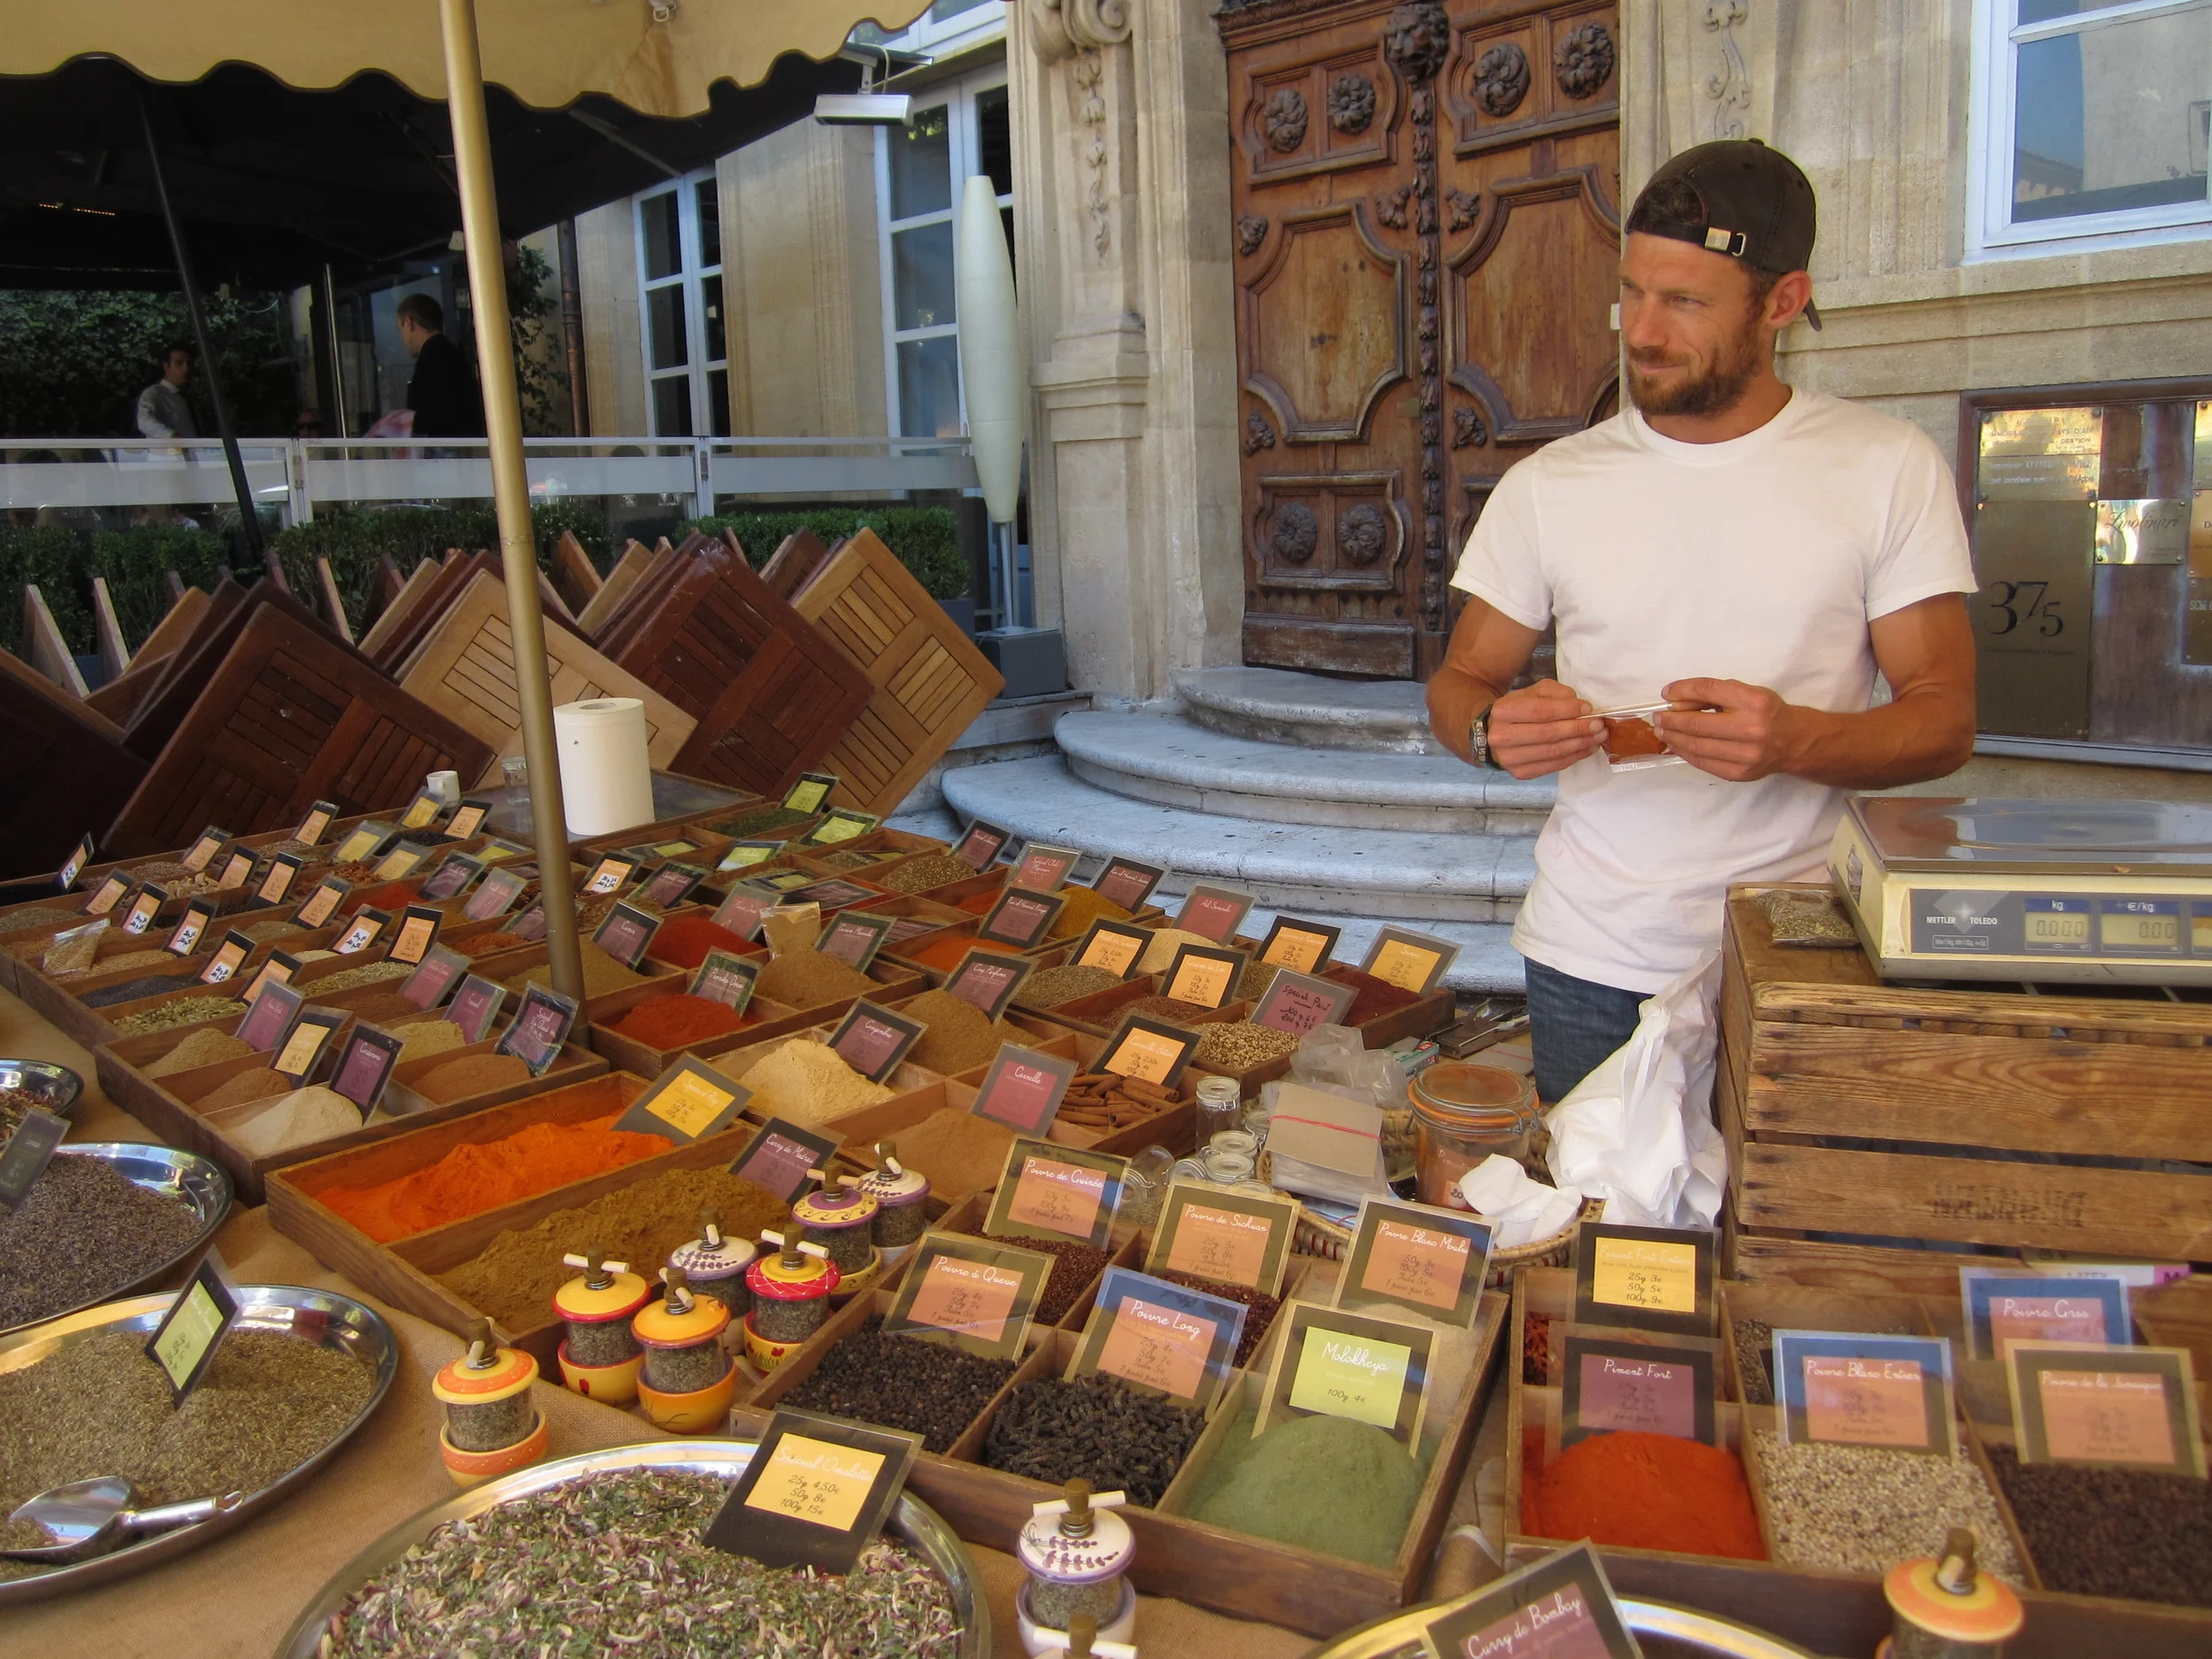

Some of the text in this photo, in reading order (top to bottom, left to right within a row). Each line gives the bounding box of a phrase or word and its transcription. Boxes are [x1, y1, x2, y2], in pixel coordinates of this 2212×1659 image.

[2052, 900, 2063, 911] kg
[2127, 902, 2154, 913] €/kg
[1926, 916, 1998, 926] METTLER TOLEDO
[1025, 1159, 1055, 1179] Poivre
[1056, 1170, 1068, 1182] de
[1184, 1204, 1268, 1233] Poivre de Sichuan
[1379, 1222, 1409, 1240] Poivre
[1410, 1229, 1438, 1247] Blanc
[934, 1256, 1018, 1286] Poivre à Queue
[1627, 1272, 1647, 1285] 25g
[1627, 1283, 1645, 1295] 50g
[1626, 1293, 1647, 1305] 100g
[2003, 1299, 2050, 1317] Poivre
[1130, 1300, 1202, 1340] Poivre Long
[1321, 1340, 1388, 1377] Molokheya
[1603, 1358, 1672, 1379] Piment Fort
[1326, 1387, 1349, 1402] 100g
[787, 1474, 808, 1489] 25g
[789, 1487, 809, 1502] 50g
[780, 1498, 803, 1514] 100g
[1467, 1593, 1581, 1659] Curry de Bombay
